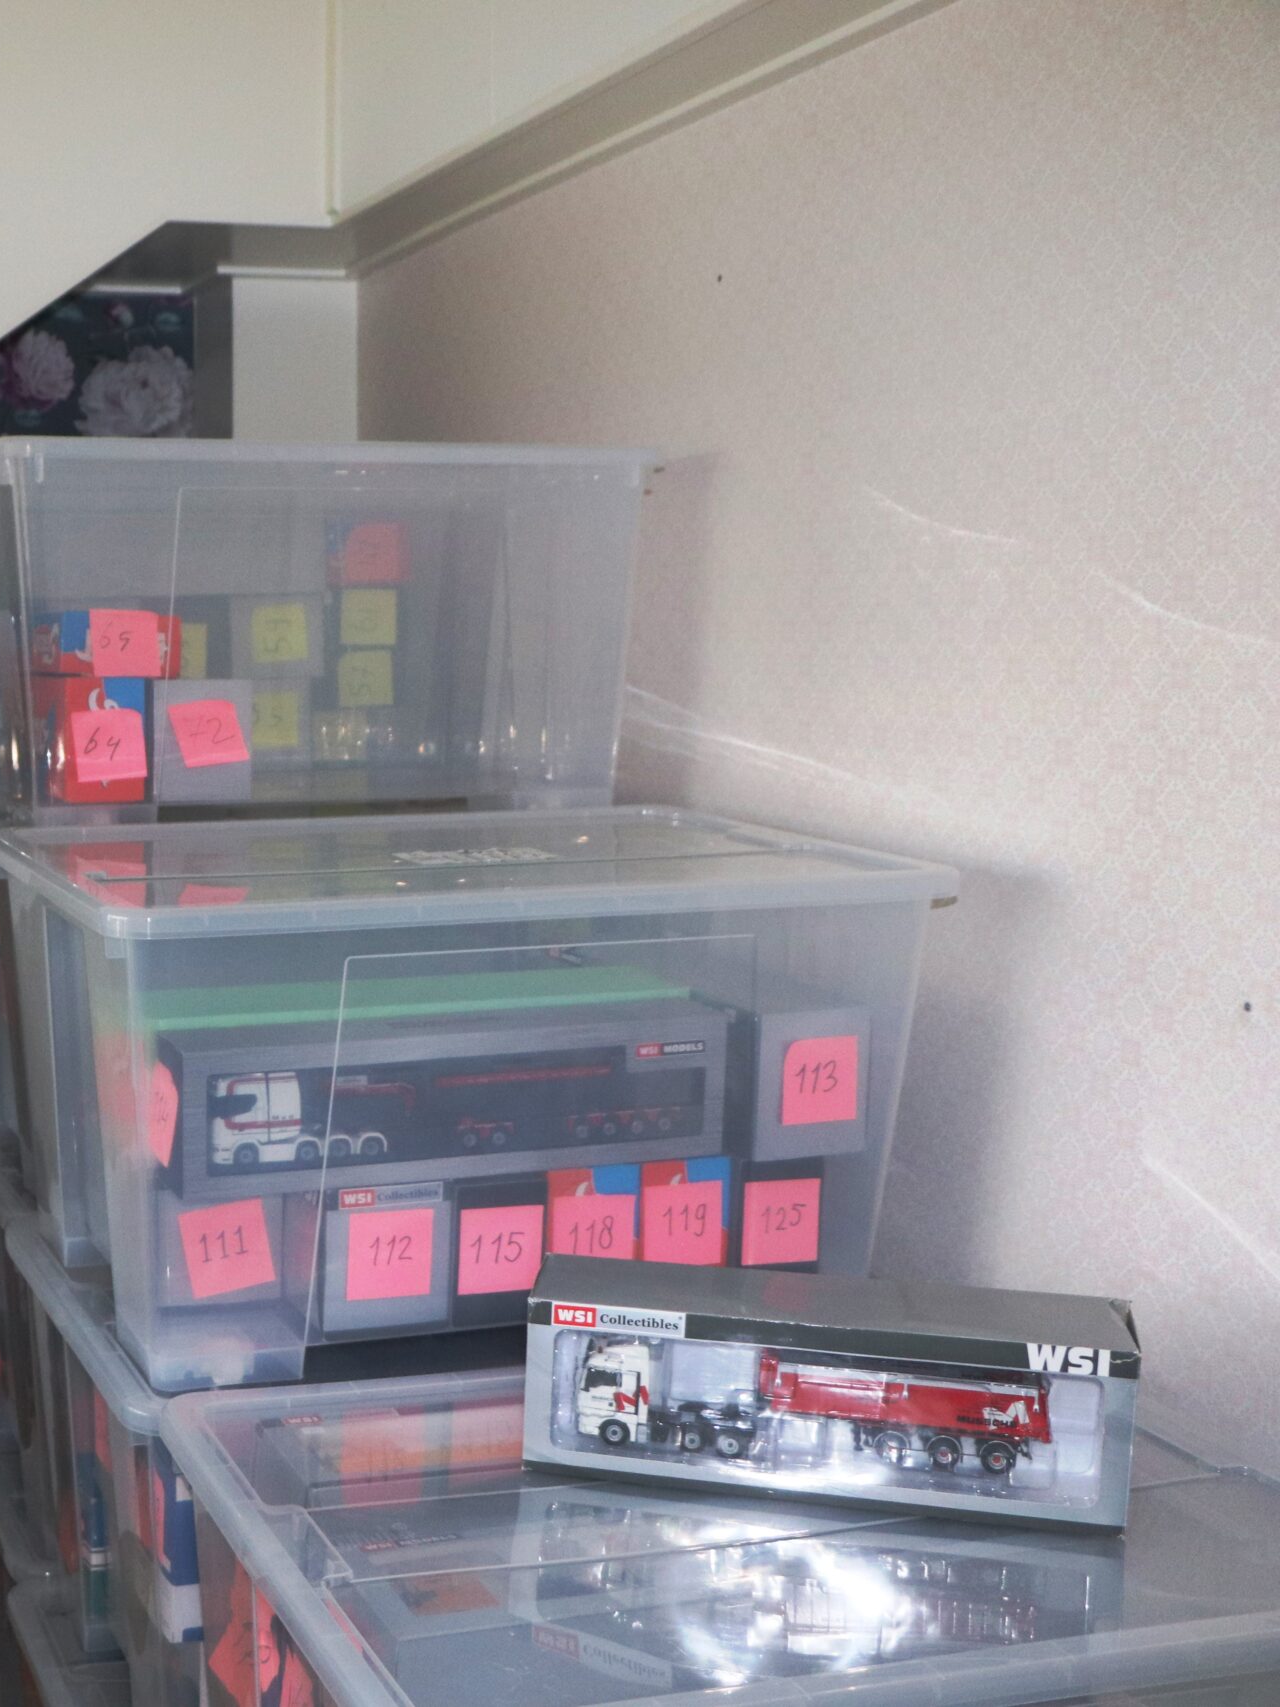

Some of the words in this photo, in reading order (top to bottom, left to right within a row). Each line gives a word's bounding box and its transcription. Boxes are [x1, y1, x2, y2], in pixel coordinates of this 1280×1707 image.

[83, 726, 121, 761] 64
[638, 1046, 660, 1056] WSI
[663, 1041, 705, 1053] MODELS
[795, 1060, 839, 1095] 113
[342, 1192, 373, 1205] WSI
[377, 1185, 440, 1202] Collectibles
[569, 1215, 615, 1254] 118
[662, 1202, 708, 1237] 119
[761, 1202, 807, 1234] 125
[198, 1225, 249, 1264] 111
[369, 1235, 414, 1267] 112
[470, 1231, 525, 1264] 115
[557, 1308, 593, 1323] WSI
[599, 1313, 680, 1331] Collectibles
[1026, 1342, 1111, 1377] WSI
